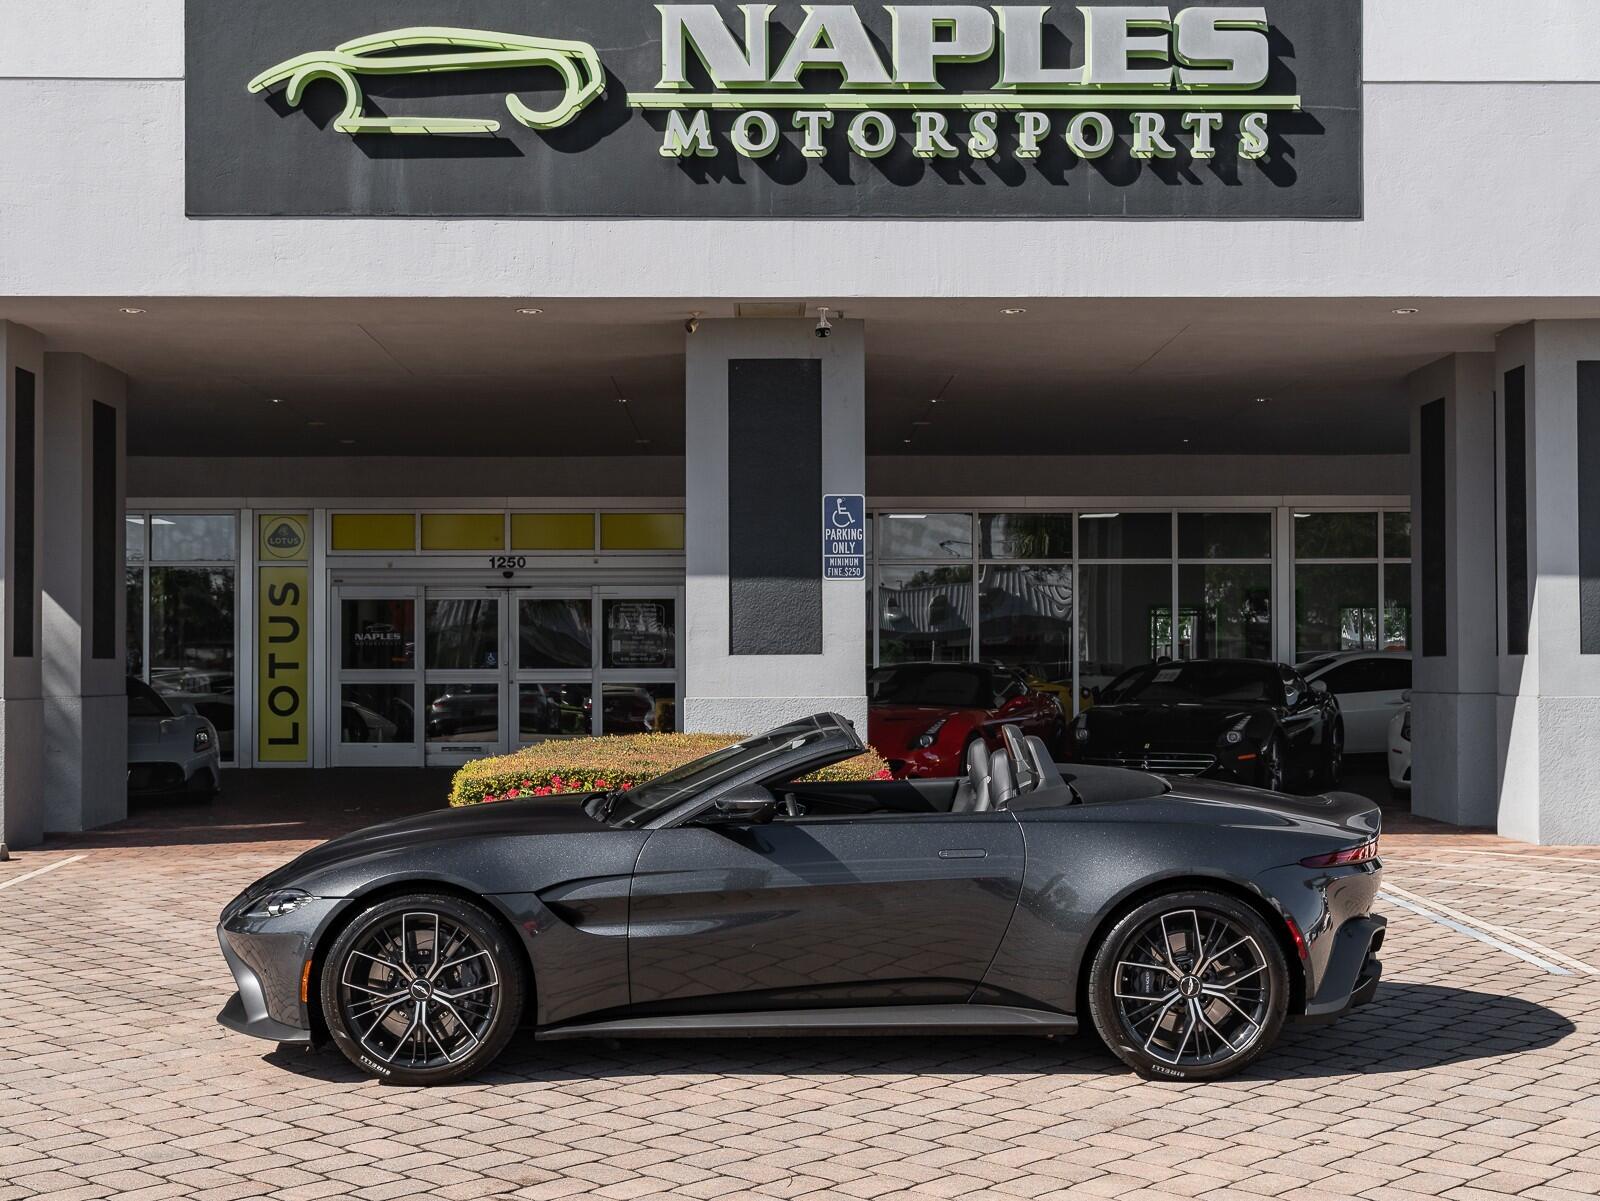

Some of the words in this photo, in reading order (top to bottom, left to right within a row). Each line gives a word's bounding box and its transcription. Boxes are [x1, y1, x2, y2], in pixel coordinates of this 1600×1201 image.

[655, 4, 1270, 91] NAPLES
[659, 110, 1270, 159] MOTORSPORTS
[825, 528, 863, 541] PARKING
[269, 537, 299, 545] LOTUS
[832, 541, 856, 554] ONLY
[489, 556, 526, 568] 1250
[829, 557, 859, 566] MINIMUM
[827, 567, 843, 576] FINE
[844, 567, 861, 577] $250
[353, 632, 401, 641] NAPLES
[268, 582, 300, 745] LOTUS
